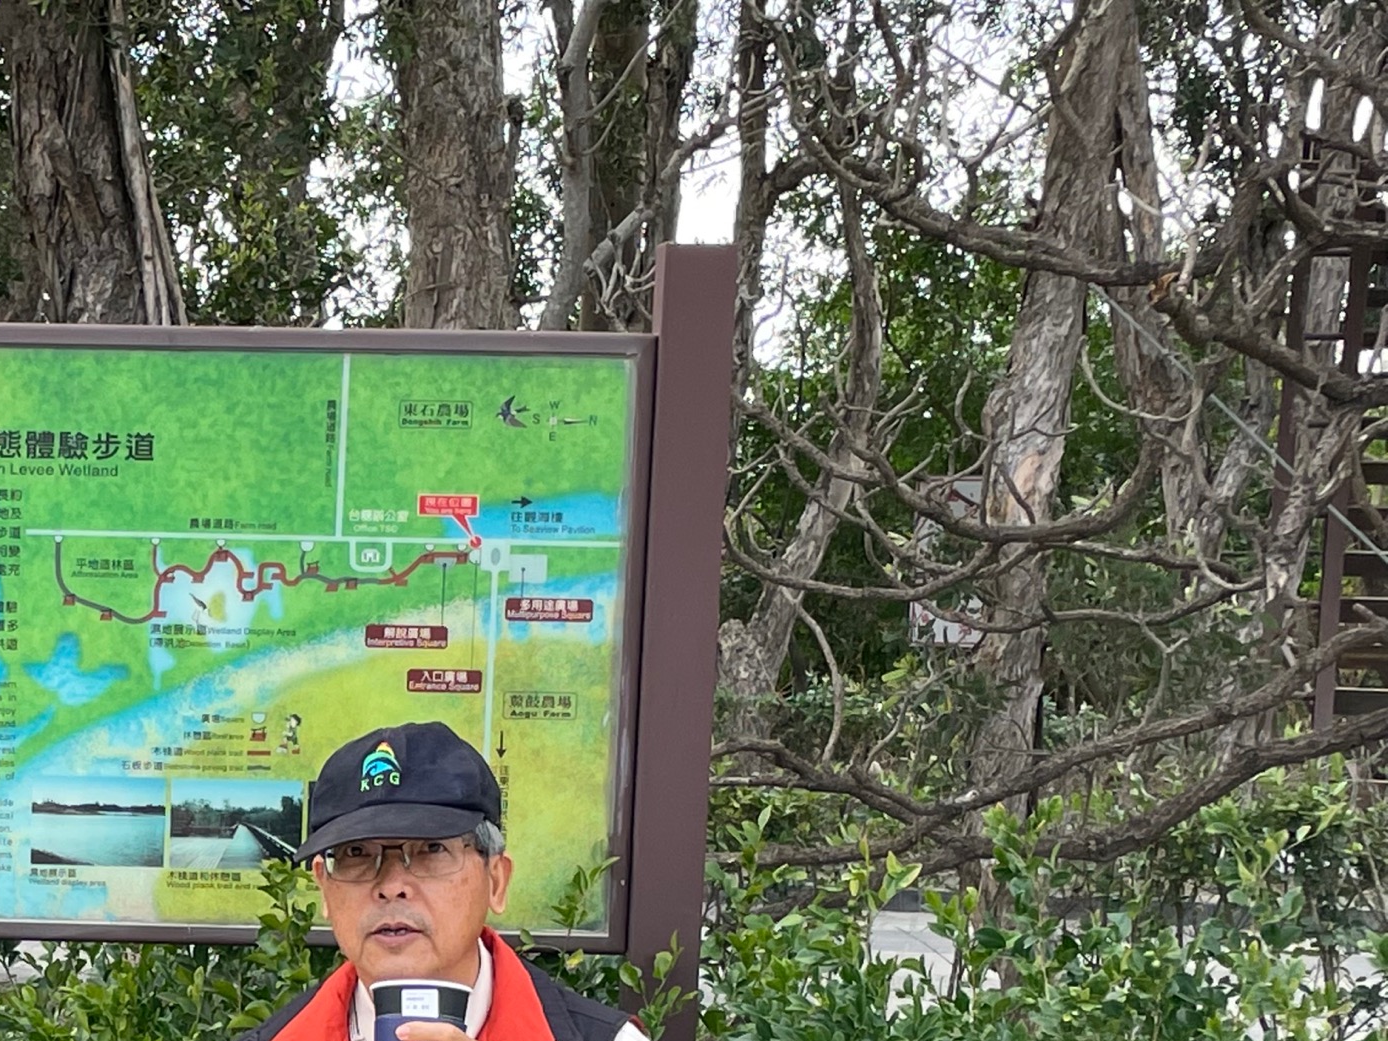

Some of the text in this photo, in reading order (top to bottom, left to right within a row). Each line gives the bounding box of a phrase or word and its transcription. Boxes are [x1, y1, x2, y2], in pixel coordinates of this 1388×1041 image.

[403, 403, 470, 418] 東石農場
[549, 400, 561, 410] W
[532, 413, 598, 426] S N
[548, 431, 557, 442] E
[9, 463, 54, 476] Levee
[58, 463, 119, 477] Wetland
[511, 524, 521, 533] To
[543, 710, 572, 718] Farm
[360, 771, 401, 793] KCG
